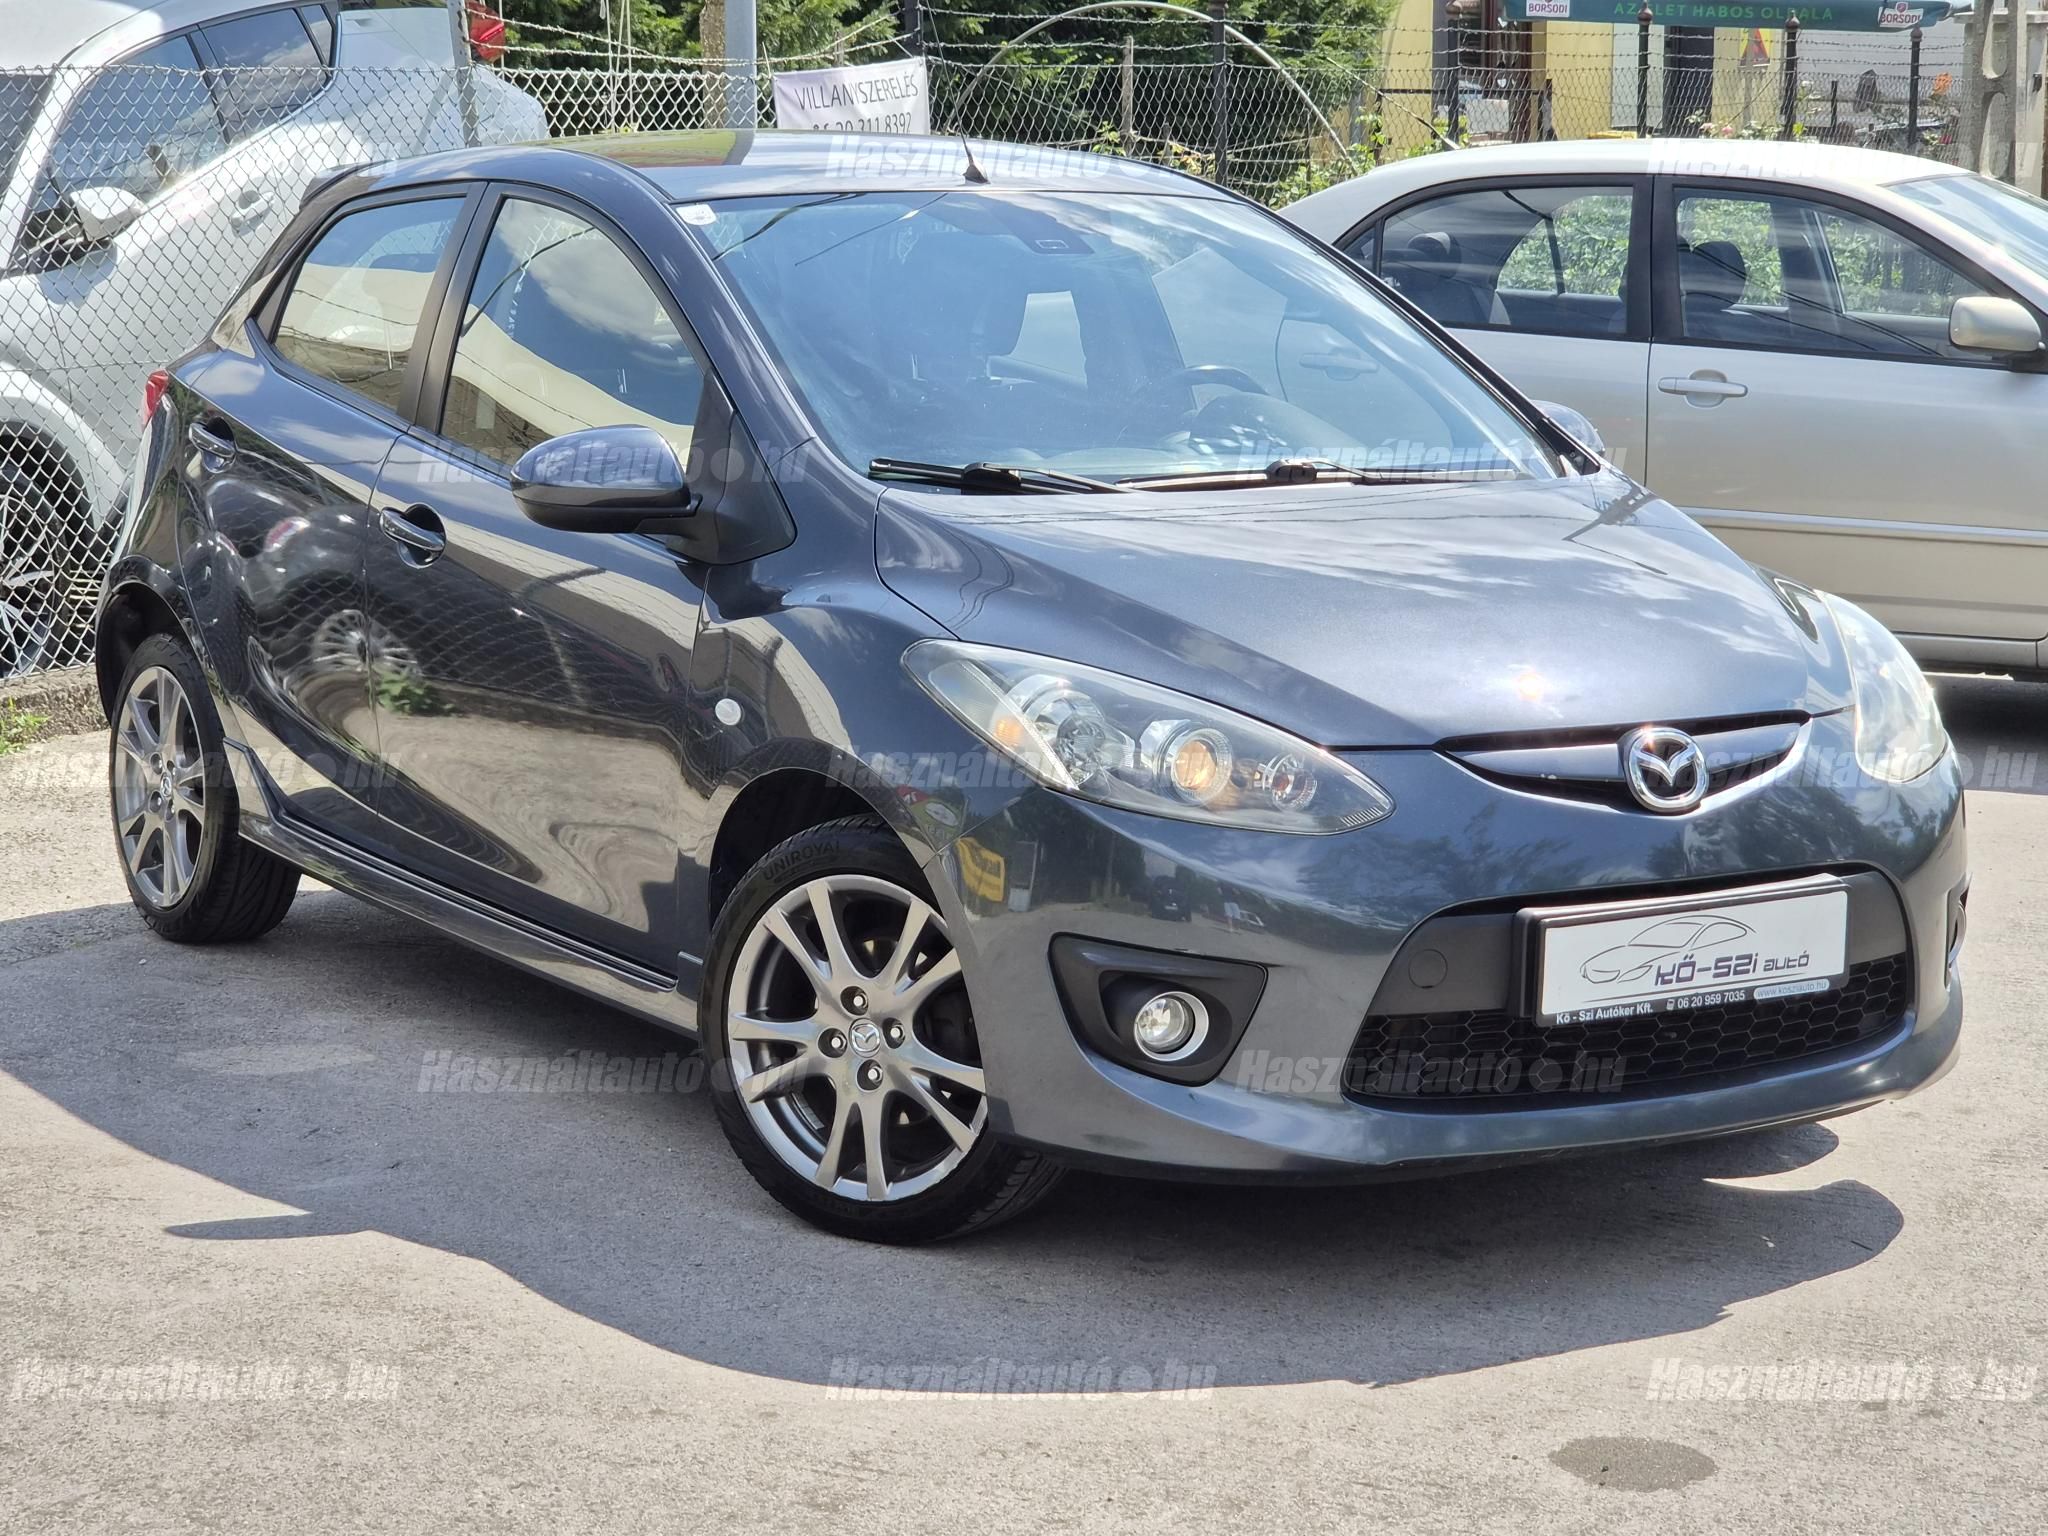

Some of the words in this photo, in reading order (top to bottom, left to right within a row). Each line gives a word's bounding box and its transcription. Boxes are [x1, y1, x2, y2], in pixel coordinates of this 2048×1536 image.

[1528, 3, 1568, 14] BORSODI
[1613, 3, 1637, 15] AZ
[1645, 3, 1687, 17] LET
[1692, 4, 1753, 18] HABOS
[794, 71, 919, 111] VILLANYSZERELÉS
[1579, 1010, 1594, 1021] Szi
[1595, 1005, 1635, 1019] Autóker
[1636, 1003, 1653, 1015] Kft.
[1677, 998, 1689, 1009] 06
[1690, 996, 1702, 1007] 20
[1704, 993, 1721, 1005] 959
[1723, 990, 1745, 1003] 7035
